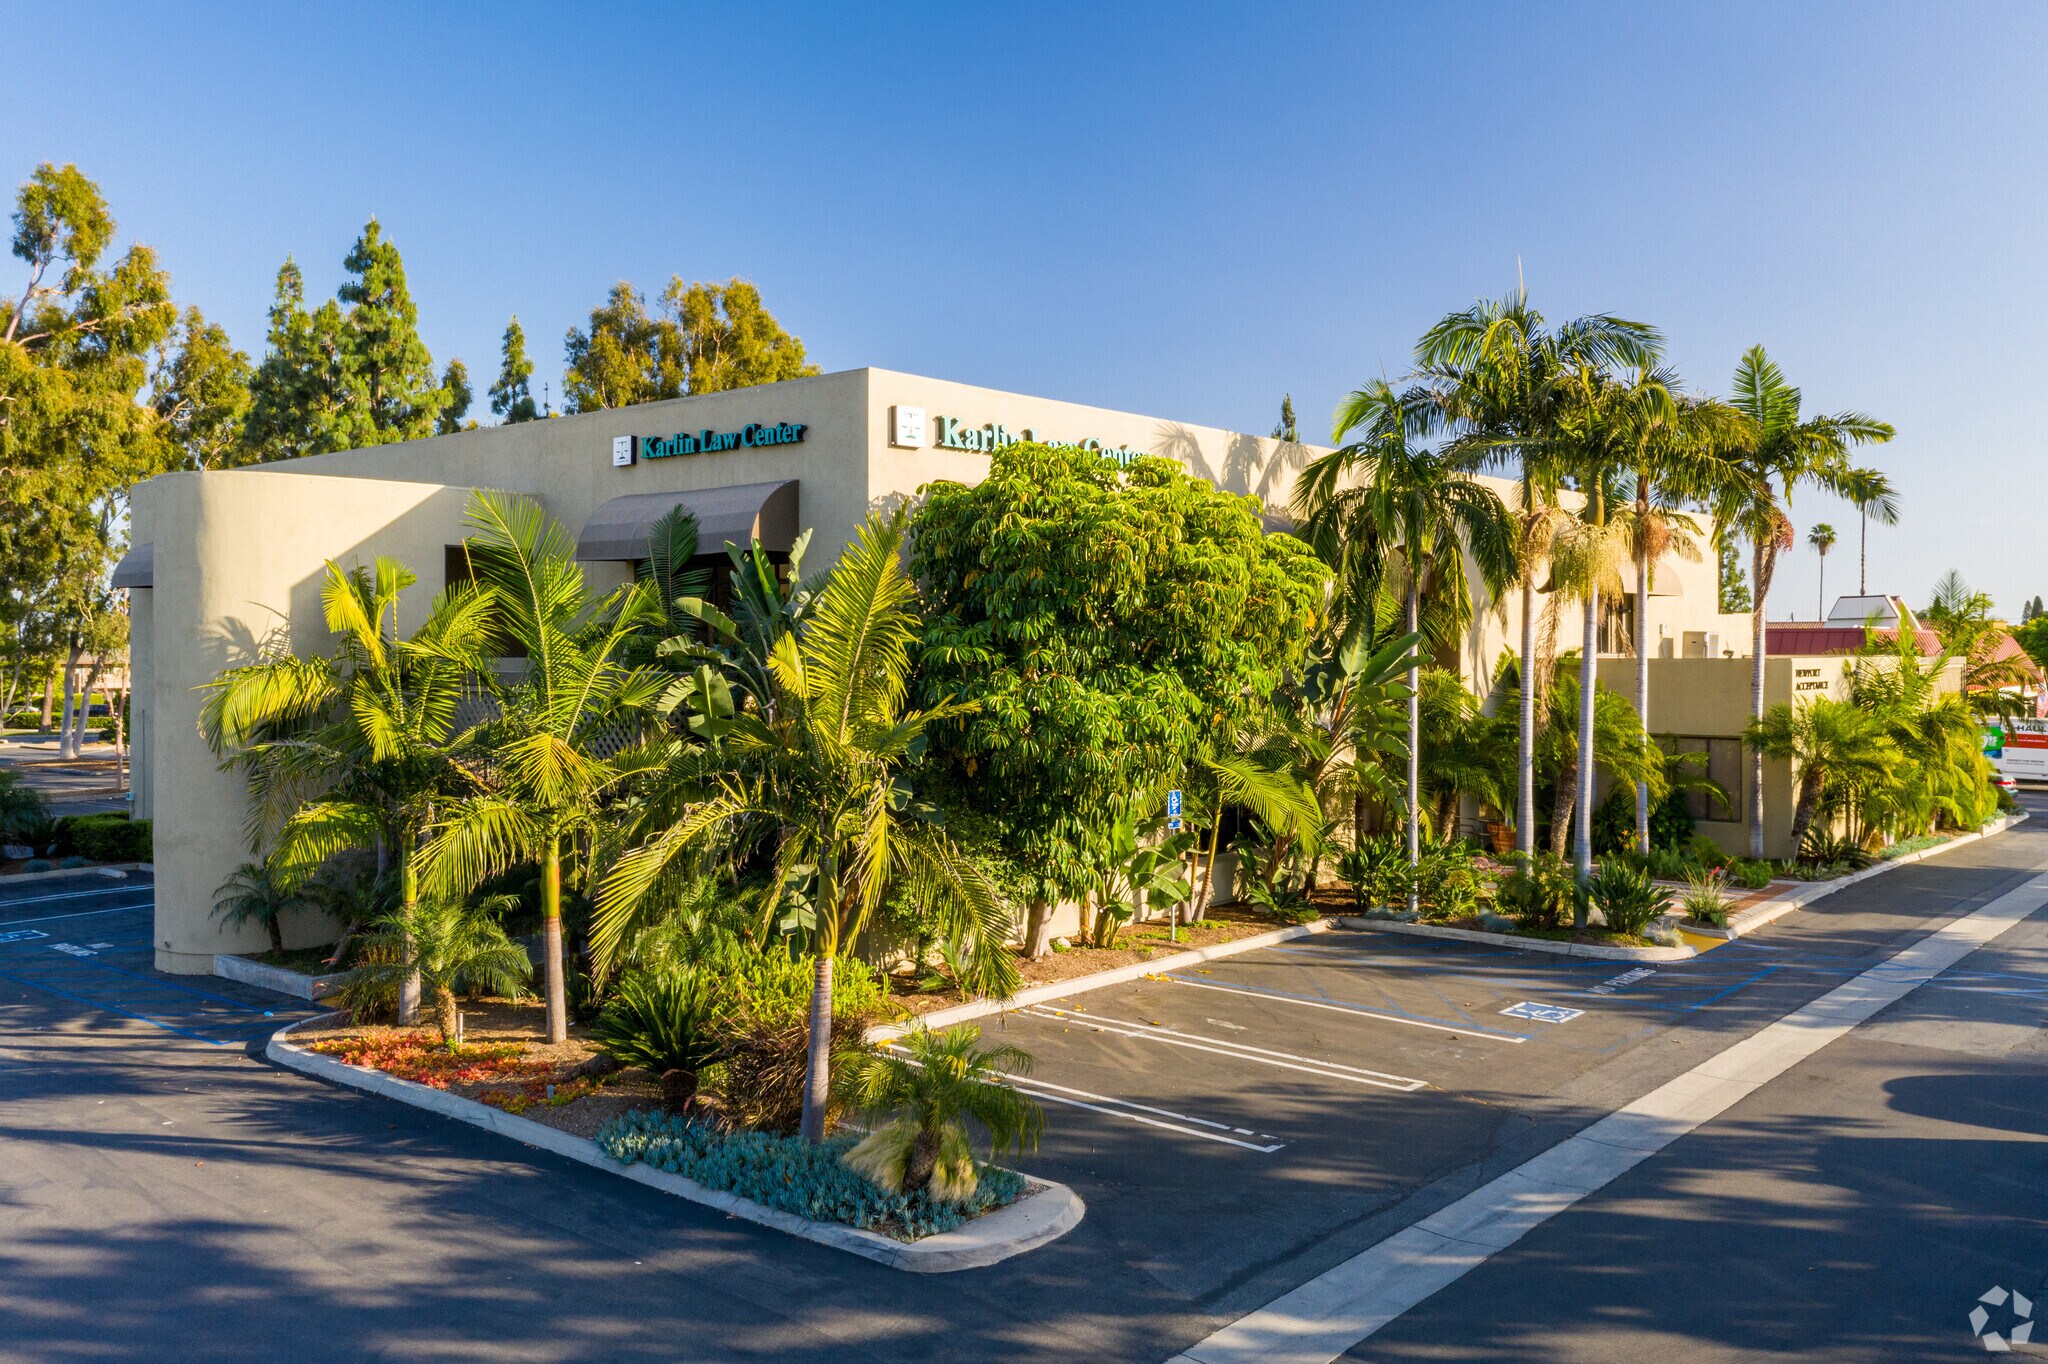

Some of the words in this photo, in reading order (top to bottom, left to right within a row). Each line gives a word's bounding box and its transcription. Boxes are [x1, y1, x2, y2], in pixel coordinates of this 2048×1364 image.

[641, 432, 698, 459] Karlin
[699, 429, 740, 452] Law
[741, 422, 804, 447] Center
